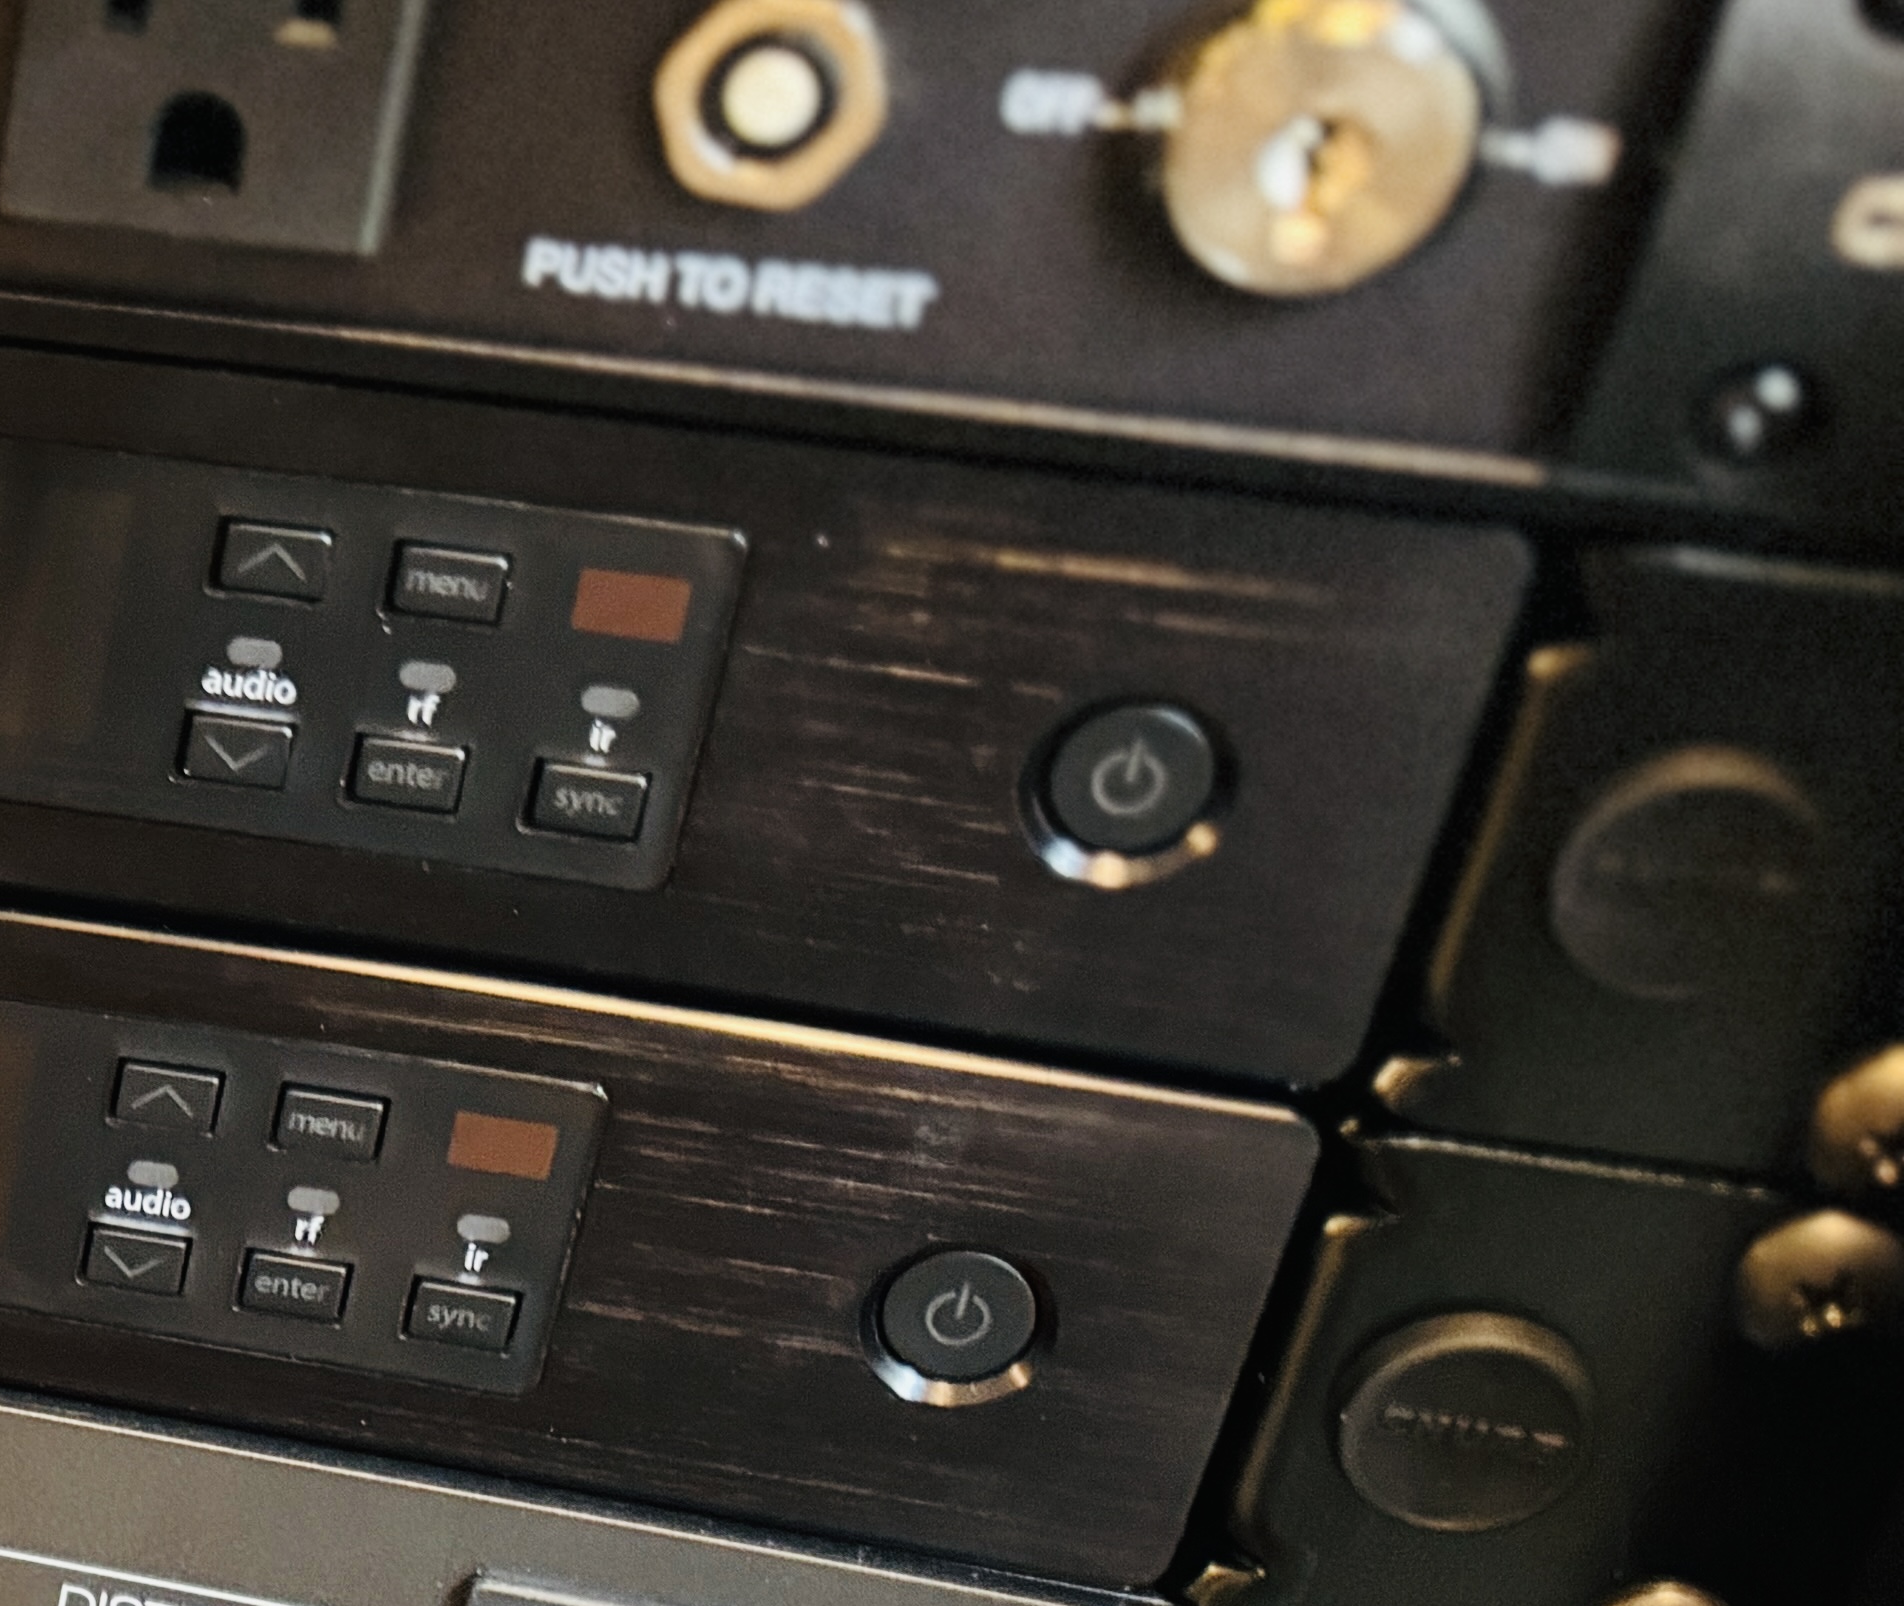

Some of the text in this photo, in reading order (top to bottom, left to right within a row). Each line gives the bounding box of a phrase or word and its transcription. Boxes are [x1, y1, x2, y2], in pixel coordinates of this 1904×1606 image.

[521, 235, 940, 330] PUSH TO RESET
[406, 566, 489, 603] menu
[201, 665, 297, 706] audio
[407, 693, 441, 728] rf
[588, 718, 617, 755] ir
[367, 758, 448, 791] enter
[554, 783, 620, 817] sync
[287, 1108, 367, 1142] menu
[104, 1184, 192, 1222] audio
[294, 1215, 325, 1245] rf
[464, 1242, 490, 1274] ir
[254, 1271, 329, 1304] enter
[426, 1300, 490, 1333] sync
